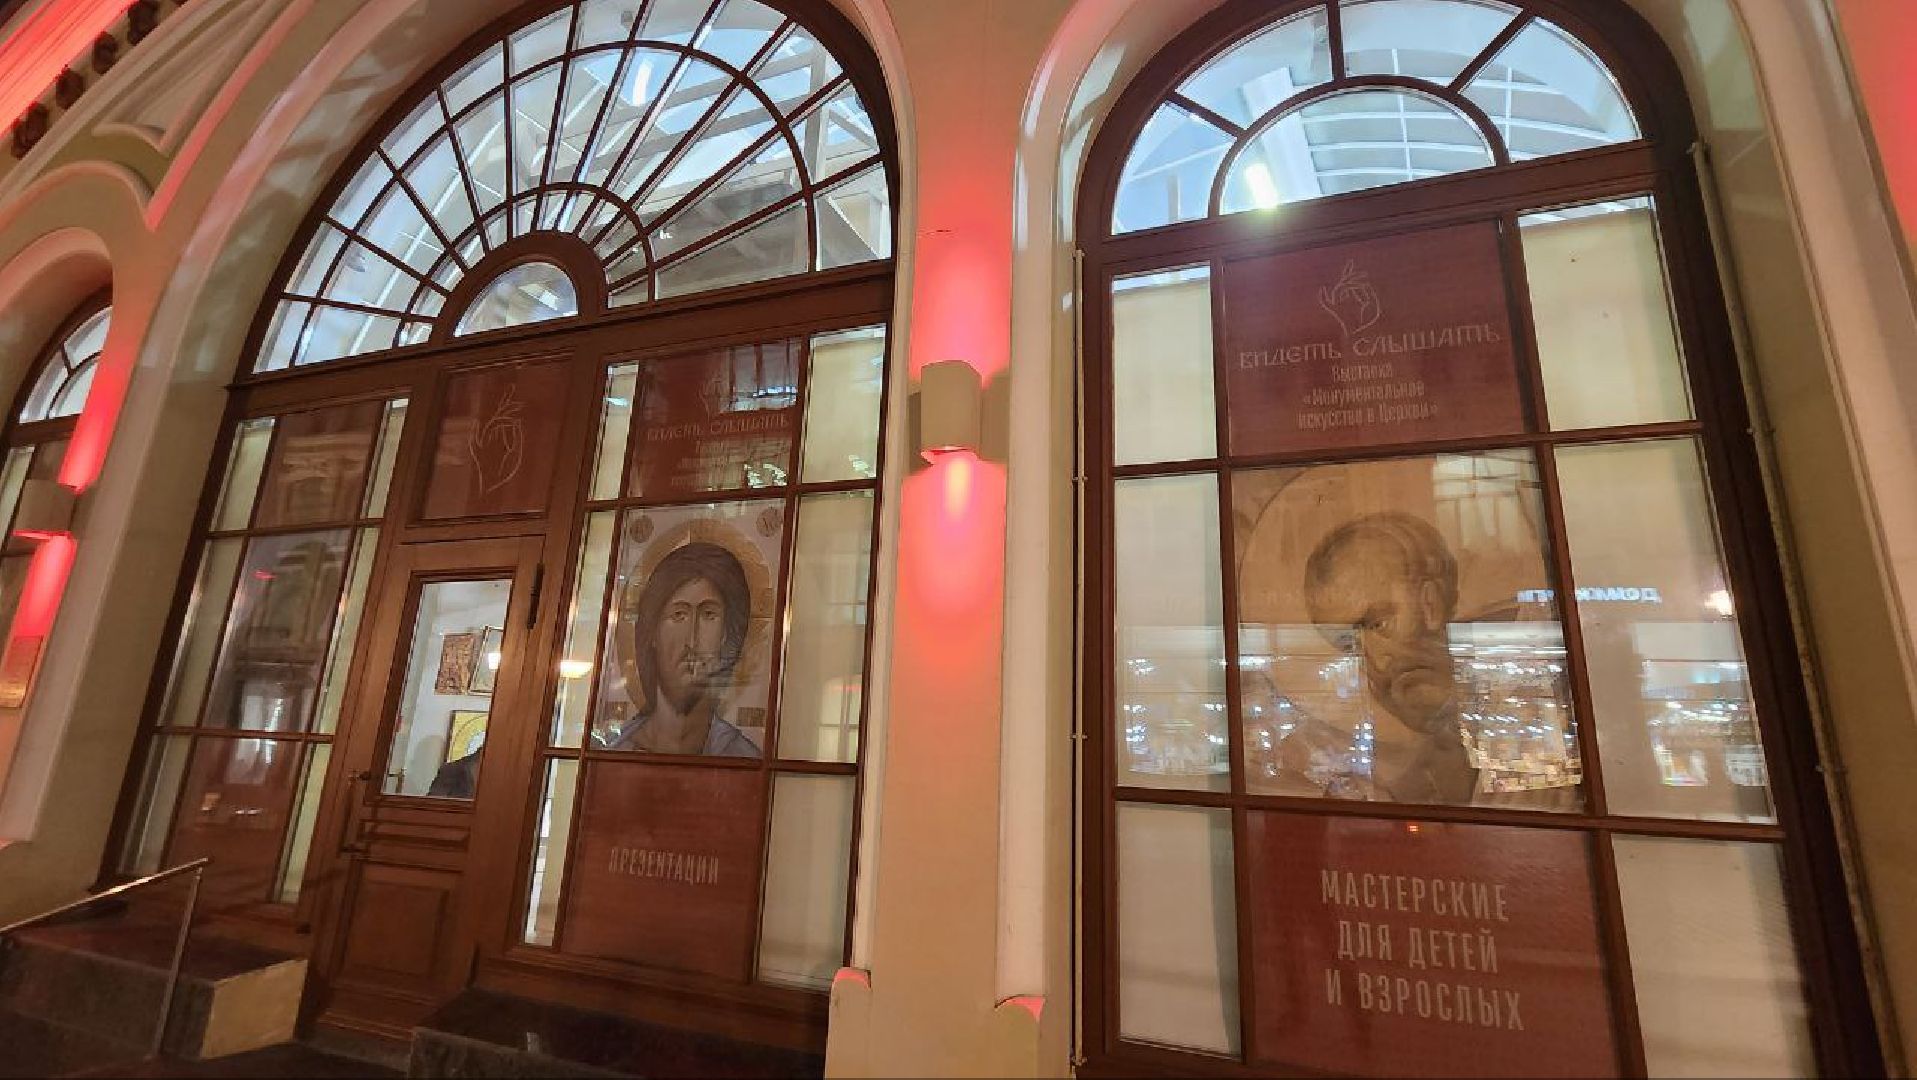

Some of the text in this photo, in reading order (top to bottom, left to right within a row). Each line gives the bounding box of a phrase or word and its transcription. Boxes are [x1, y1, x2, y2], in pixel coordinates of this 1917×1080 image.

[1353, 323, 1500, 357] СЛЫШАТЬ
[608, 847, 719, 886] ПРЕЗЕНТАЦИИ
[1321, 869, 1510, 922] МАСТЕРСКИЕ
[1337, 920, 1498, 974] ДЛЯ ДЕТЕЙ
[1325, 968, 1525, 1031] И ВЗРОСЛЫХ
